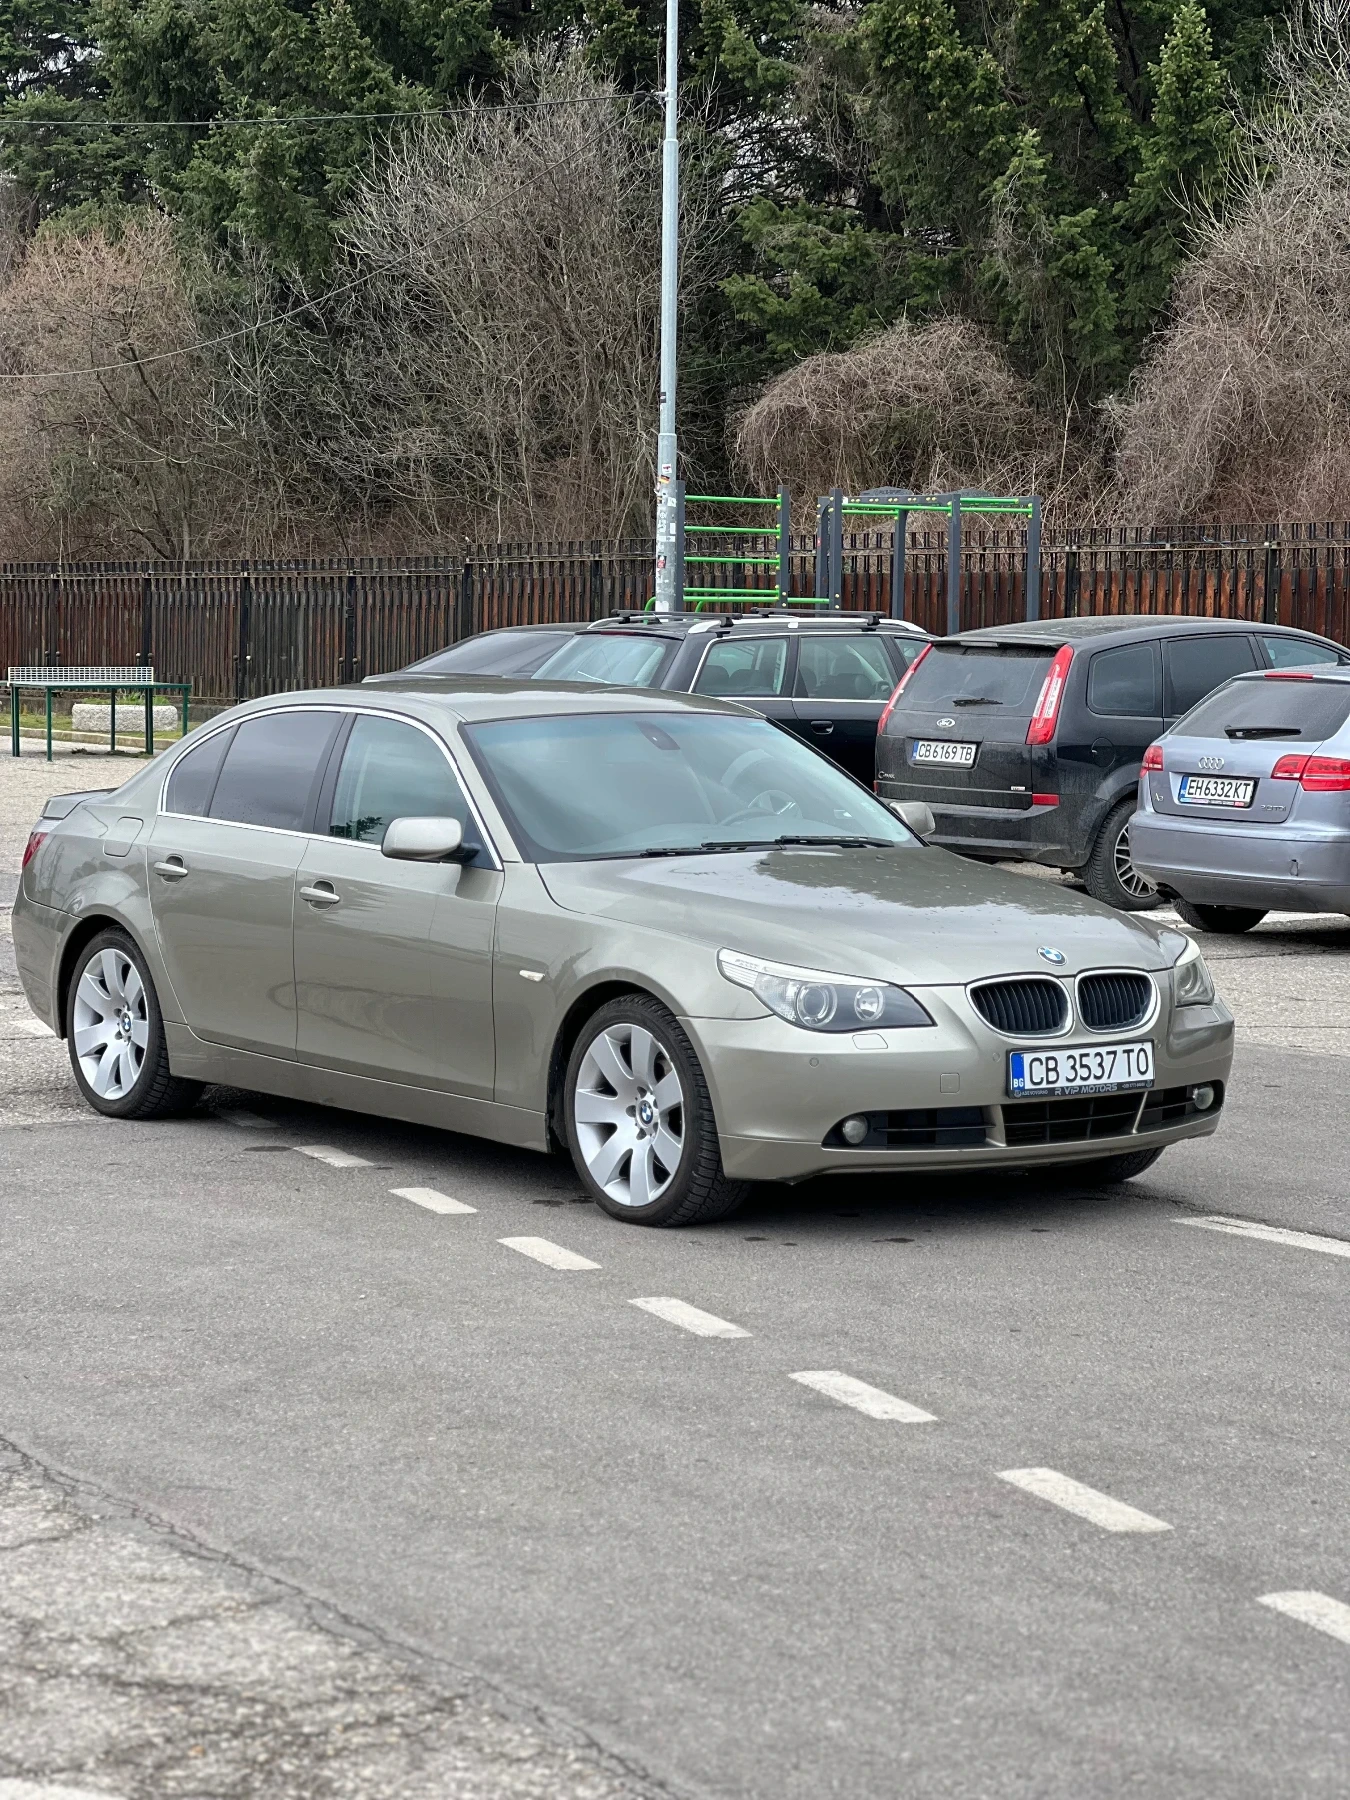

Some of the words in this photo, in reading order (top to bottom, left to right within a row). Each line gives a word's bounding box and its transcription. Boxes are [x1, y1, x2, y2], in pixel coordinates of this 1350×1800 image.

[918, 743, 932, 758] CB
[932, 744, 958, 760] 6169
[959, 746, 973, 761] TB
[1187, 779, 1204, 796] EH
[1204, 780, 1232, 798] 6332
[1232, 782, 1251, 800] KT
[1029, 1055, 1060, 1086] CB
[1065, 1049, 1118, 1082] 3537
[1122, 1047, 1149, 1077] TO
[1013, 1078, 1024, 1088] BG
[1054, 1087, 1062, 1096] R
[1081, 1082, 1118, 1094] MOTORS
